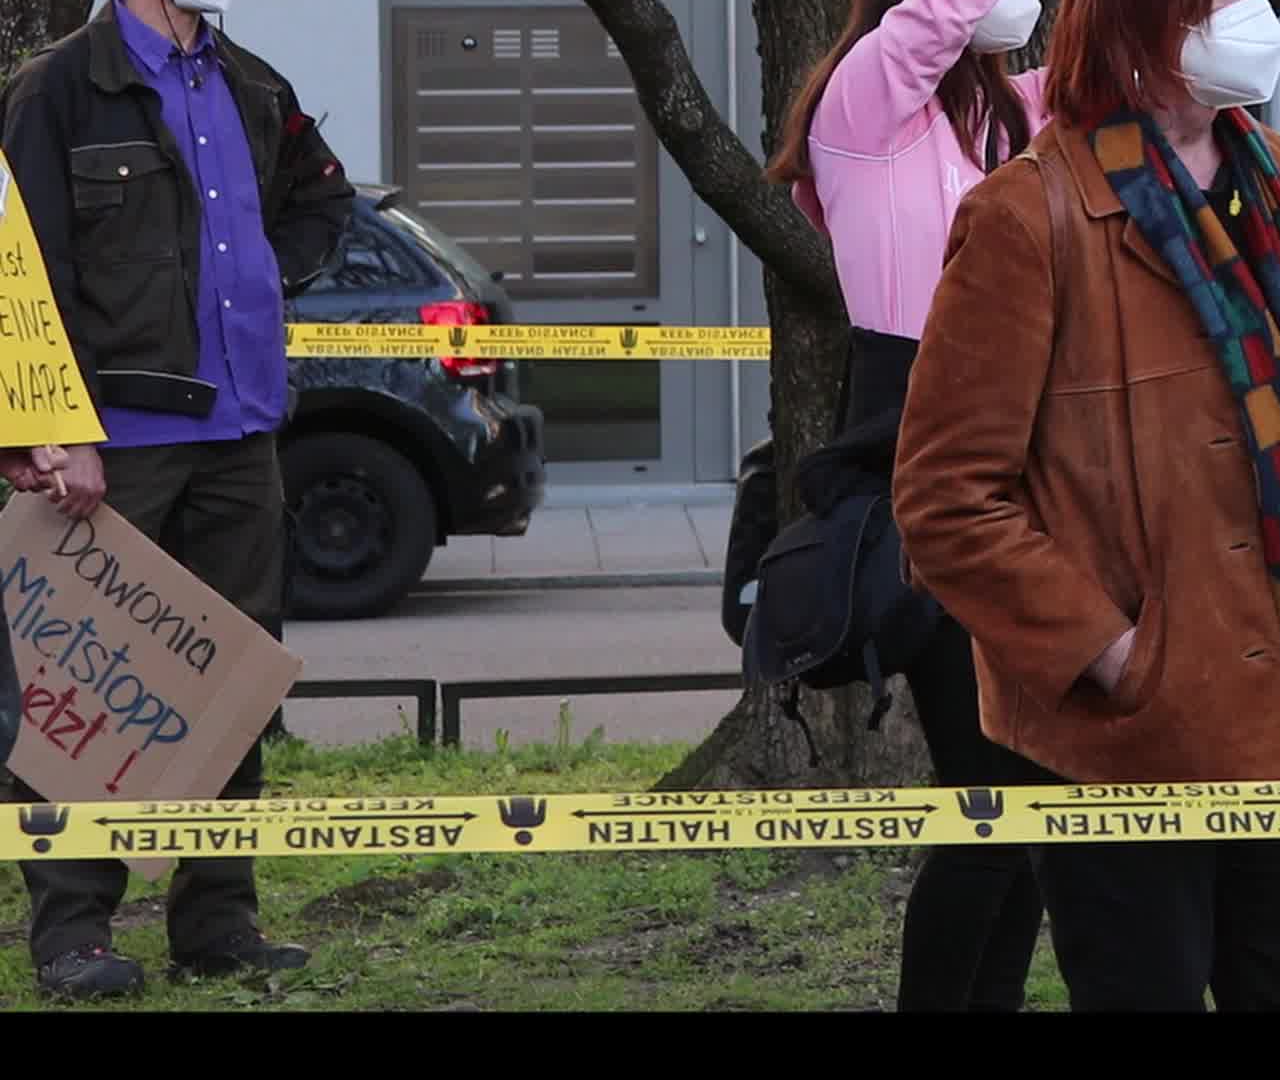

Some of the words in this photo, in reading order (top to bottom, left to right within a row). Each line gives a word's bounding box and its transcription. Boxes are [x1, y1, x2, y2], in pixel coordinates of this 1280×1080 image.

[51, 519, 216, 675] Dawonia
[0, 556, 189, 751] Mietstopp
[614, 793, 792, 806] DISTANCE
[808, 791, 896, 803] KEEP
[1067, 784, 1240, 798] DISTANCE
[589, 821, 729, 843] HALTEN
[756, 818, 925, 840] ABSTAND
[1046, 813, 1181, 835] HALTEN
[111, 829, 257, 851] HALTEN
[285, 825, 463, 848] ABSTAND
